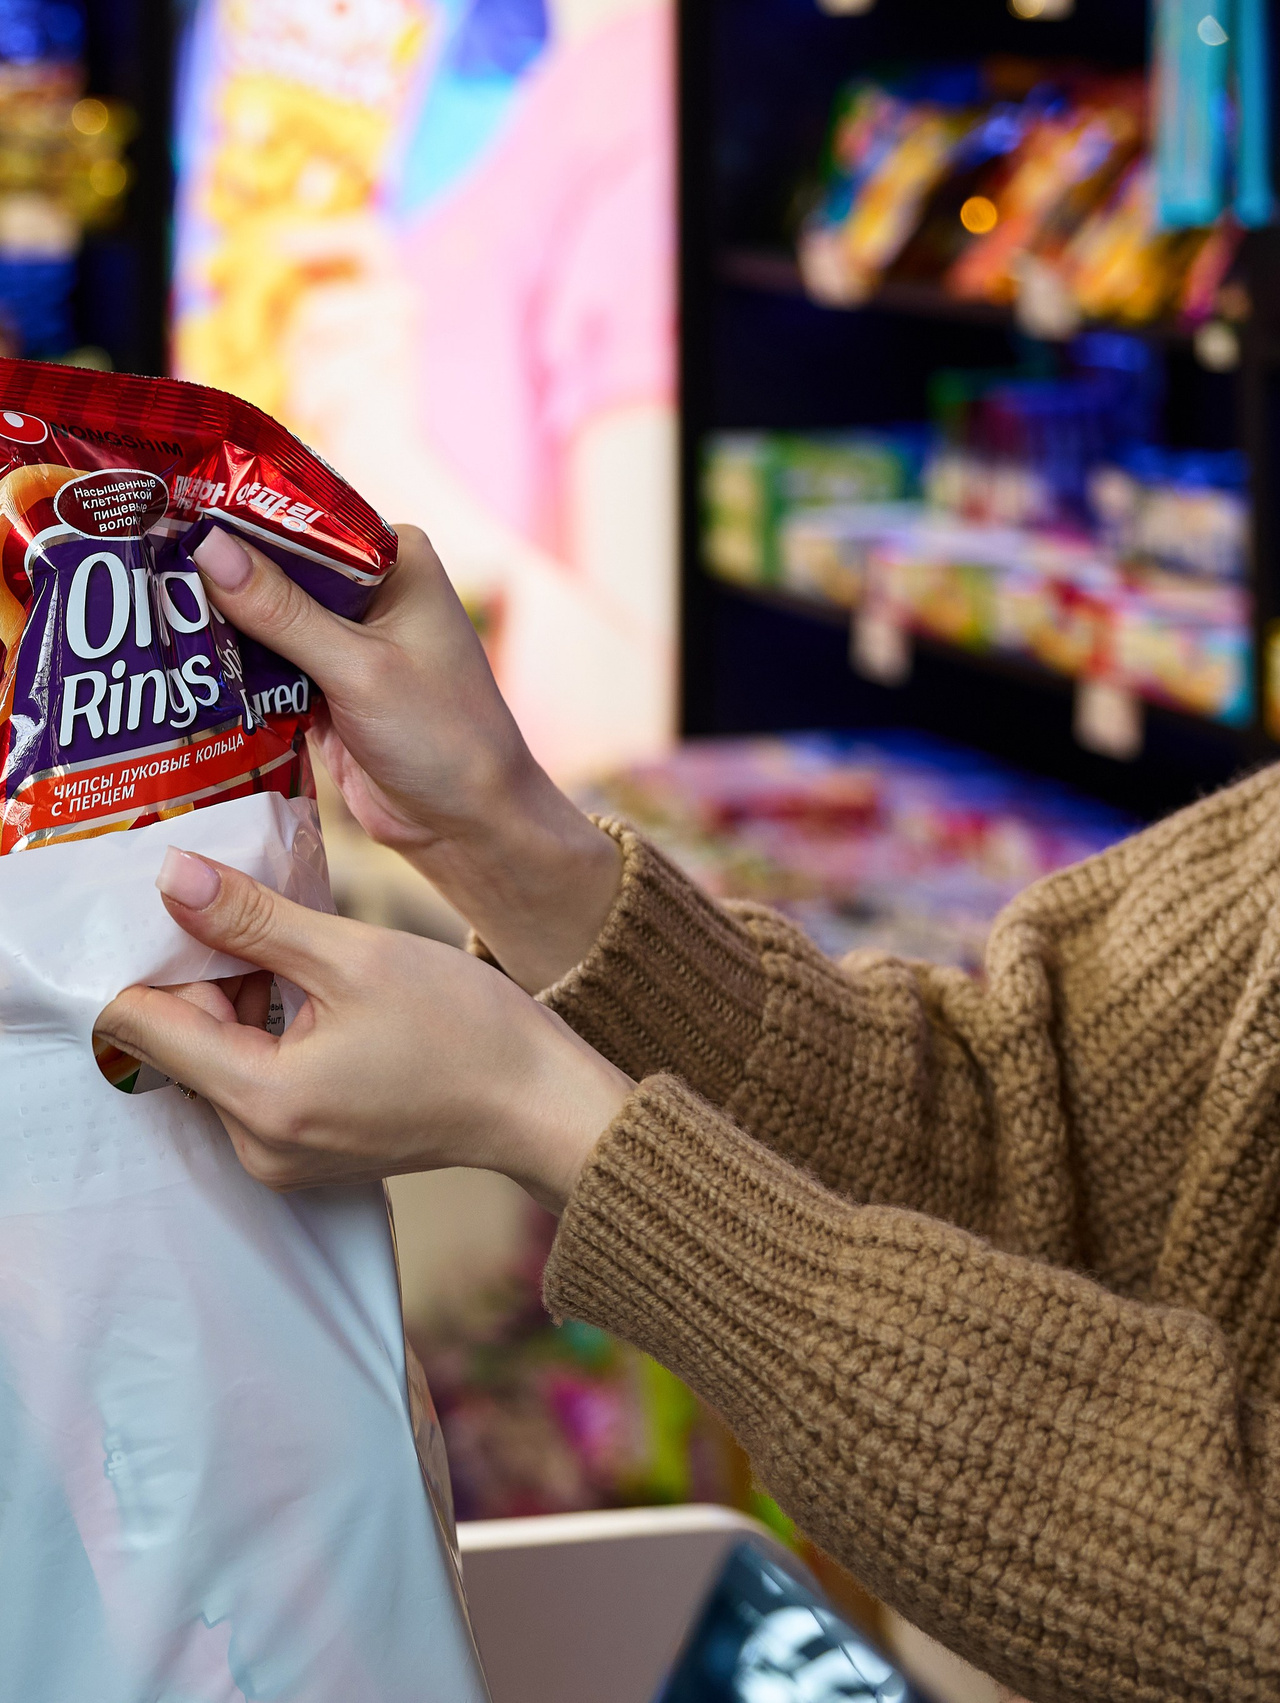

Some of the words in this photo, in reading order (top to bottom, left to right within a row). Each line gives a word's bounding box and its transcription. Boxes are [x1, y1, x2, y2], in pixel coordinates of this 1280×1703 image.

[51, 422, 184, 458] NONGSHIM
[73, 479, 156, 499] Насыщенные
[82, 489, 152, 510] клетчаткой
[58, 653, 220, 748] Rings
[53, 772, 114, 800] ЧИПСЫ
[118, 752, 192, 786] ЛУКОВЫЕ
[194, 732, 245, 767] КОЛЬЦА
[68, 783, 136, 814] ПЕРЦЕМ
